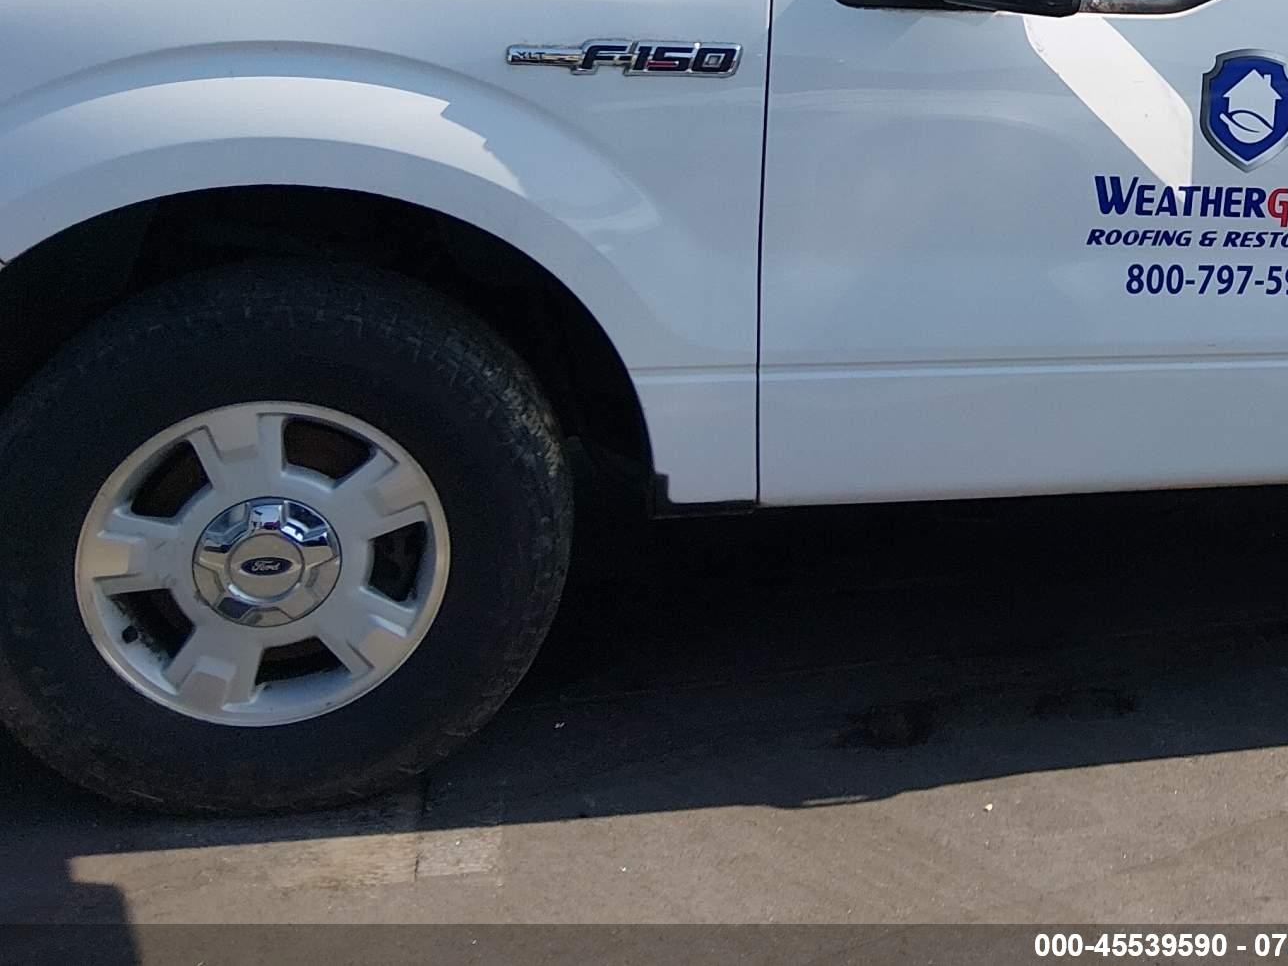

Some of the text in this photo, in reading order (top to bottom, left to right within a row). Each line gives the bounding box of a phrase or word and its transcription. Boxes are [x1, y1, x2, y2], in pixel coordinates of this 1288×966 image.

[515, 39, 742, 76] XLT F-150
[1086, 228, 1193, 247] ROOFING
[1198, 230, 1218, 247] &
[251, 561, 281, 572] Ford
